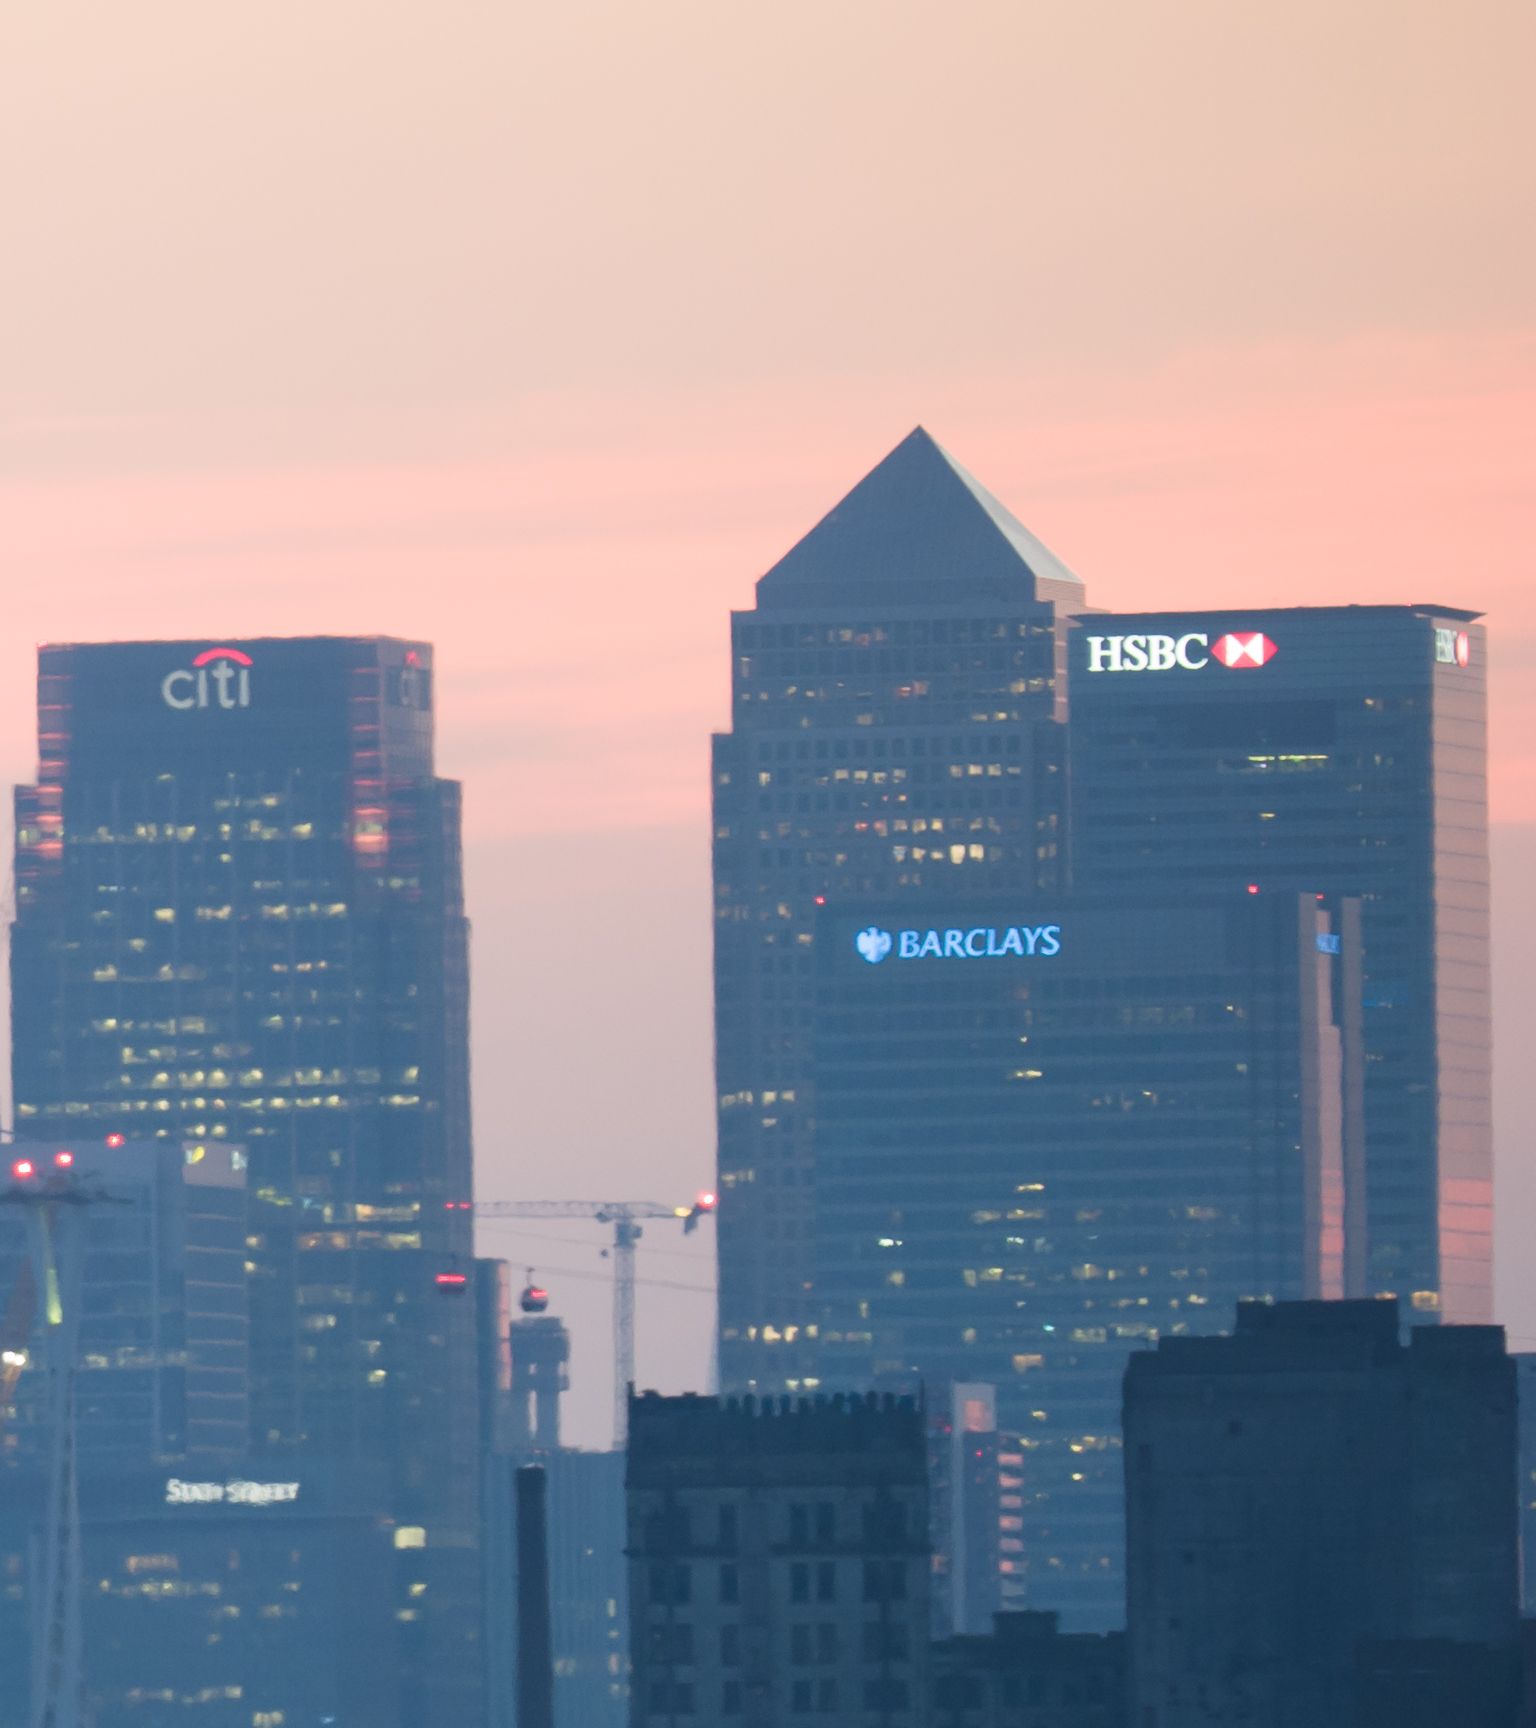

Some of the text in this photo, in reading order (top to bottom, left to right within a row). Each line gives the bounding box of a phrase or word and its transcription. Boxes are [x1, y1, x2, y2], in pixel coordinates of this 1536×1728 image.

[1086, 633, 1209, 672] HSBC
[161, 660, 250, 709] citi
[898, 925, 1061, 958] BARCLAYS
